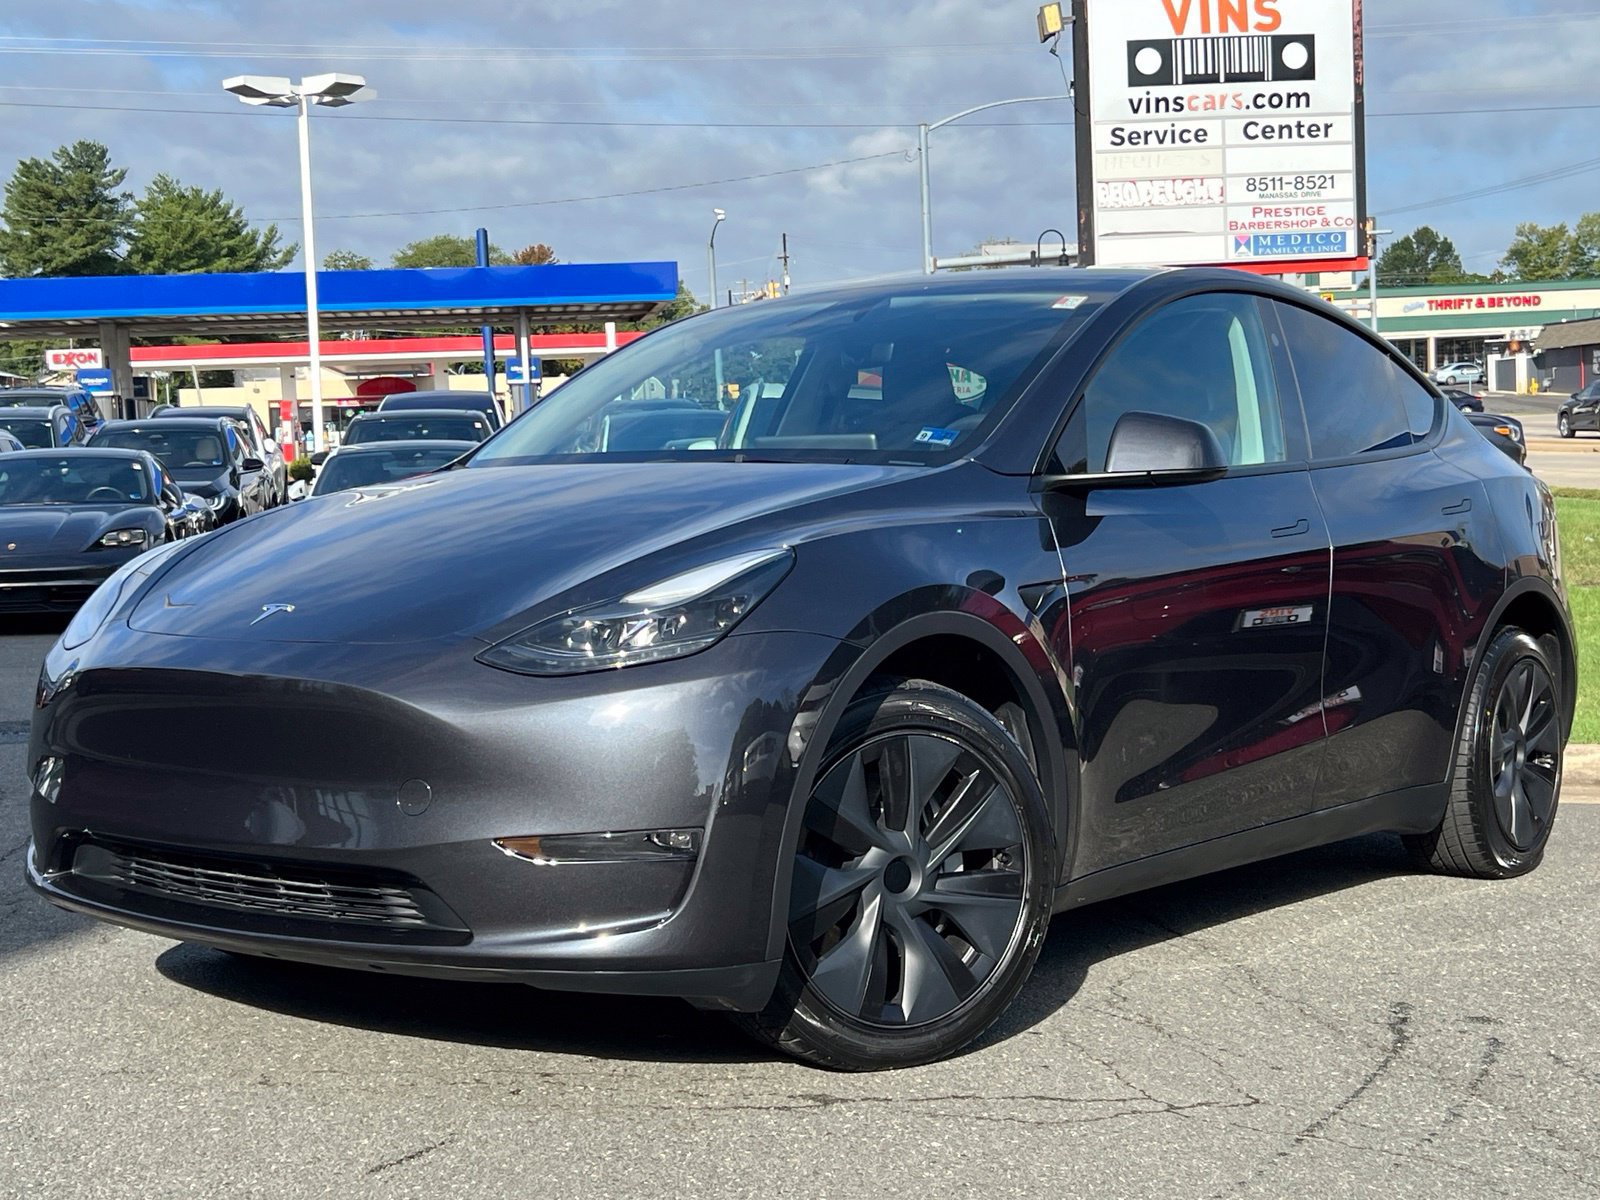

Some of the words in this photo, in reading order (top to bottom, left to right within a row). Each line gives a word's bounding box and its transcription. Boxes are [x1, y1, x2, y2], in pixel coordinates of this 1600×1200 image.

[1162, 0, 1282, 35] VINS
[1128, 90, 1311, 114] vinscars.com
[1110, 123, 1208, 146] Service
[1242, 120, 1333, 141] Center
[1246, 175, 1335, 192] 8511-8521
[1259, 191, 1299, 199] MANASSAS
[1252, 206, 1326, 218] PRESTIGE
[1228, 220, 1318, 231] BARBERSHOP
[1320, 217, 1331, 227] &
[1258, 233, 1342, 246] MEDICO
[1258, 247, 1301, 255] FAMILY
[1302, 245, 1342, 254] CLINIC
[1427, 298, 1473, 311] THRIFT
[1475, 297, 1485, 308] &
[1487, 295, 1542, 308] BEYOND
[52, 352, 98, 368] EXXON
